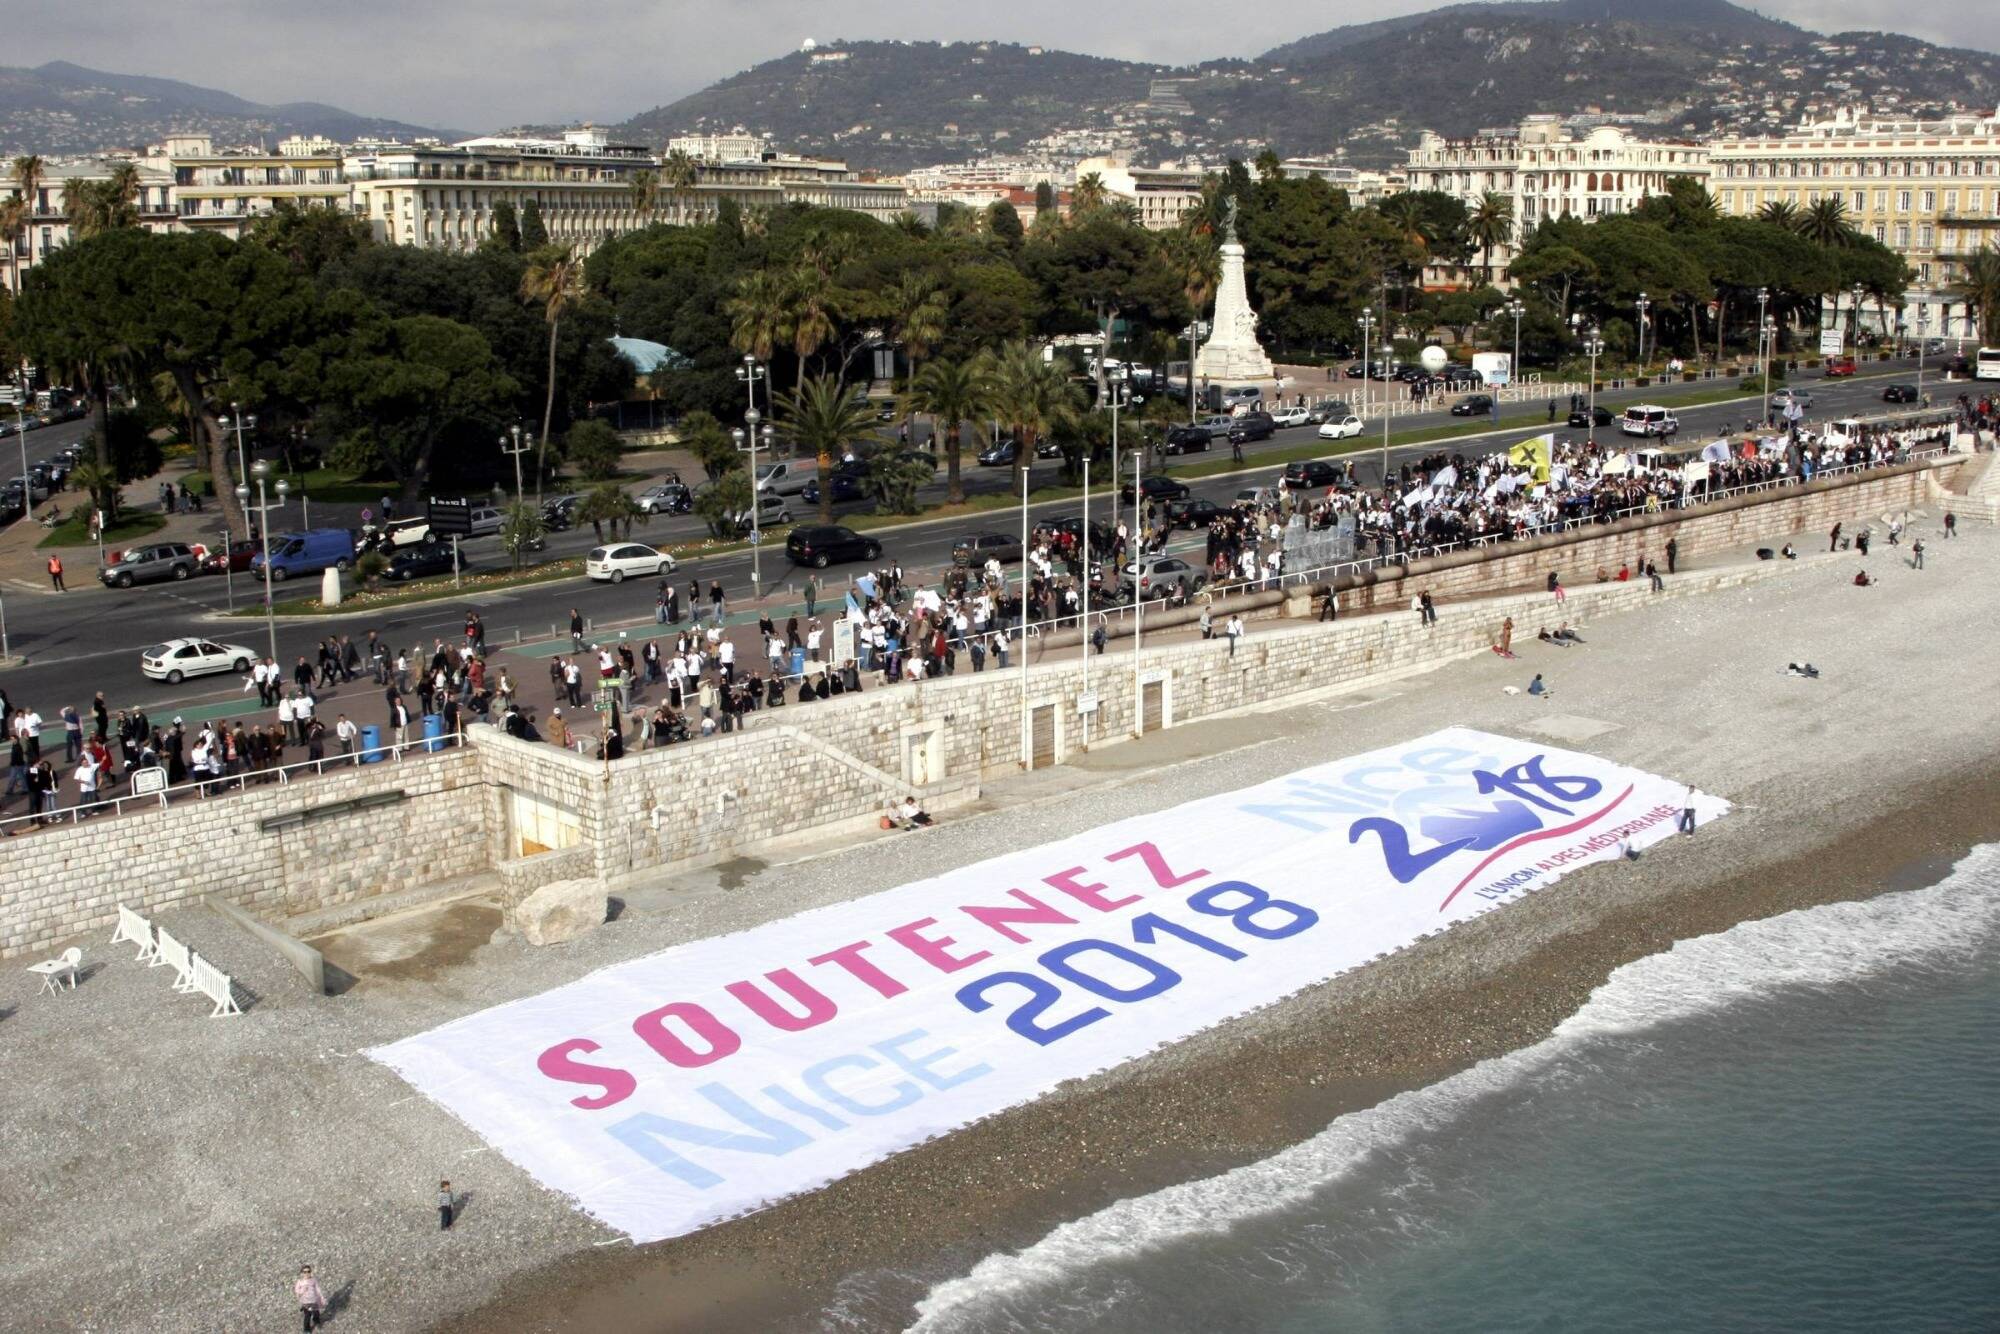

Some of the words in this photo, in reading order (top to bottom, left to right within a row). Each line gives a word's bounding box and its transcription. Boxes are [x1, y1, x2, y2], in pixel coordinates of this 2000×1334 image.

[537, 841, 1212, 1110] SOUTENEZ
[1474, 867, 1542, 900] L'UNION
[1536, 847, 1589, 872] ALPES
[1578, 804, 1682, 854] MÉDITERRANÉE
[604, 1028, 995, 1189] NICE
[955, 880, 1320, 1047] 2018
